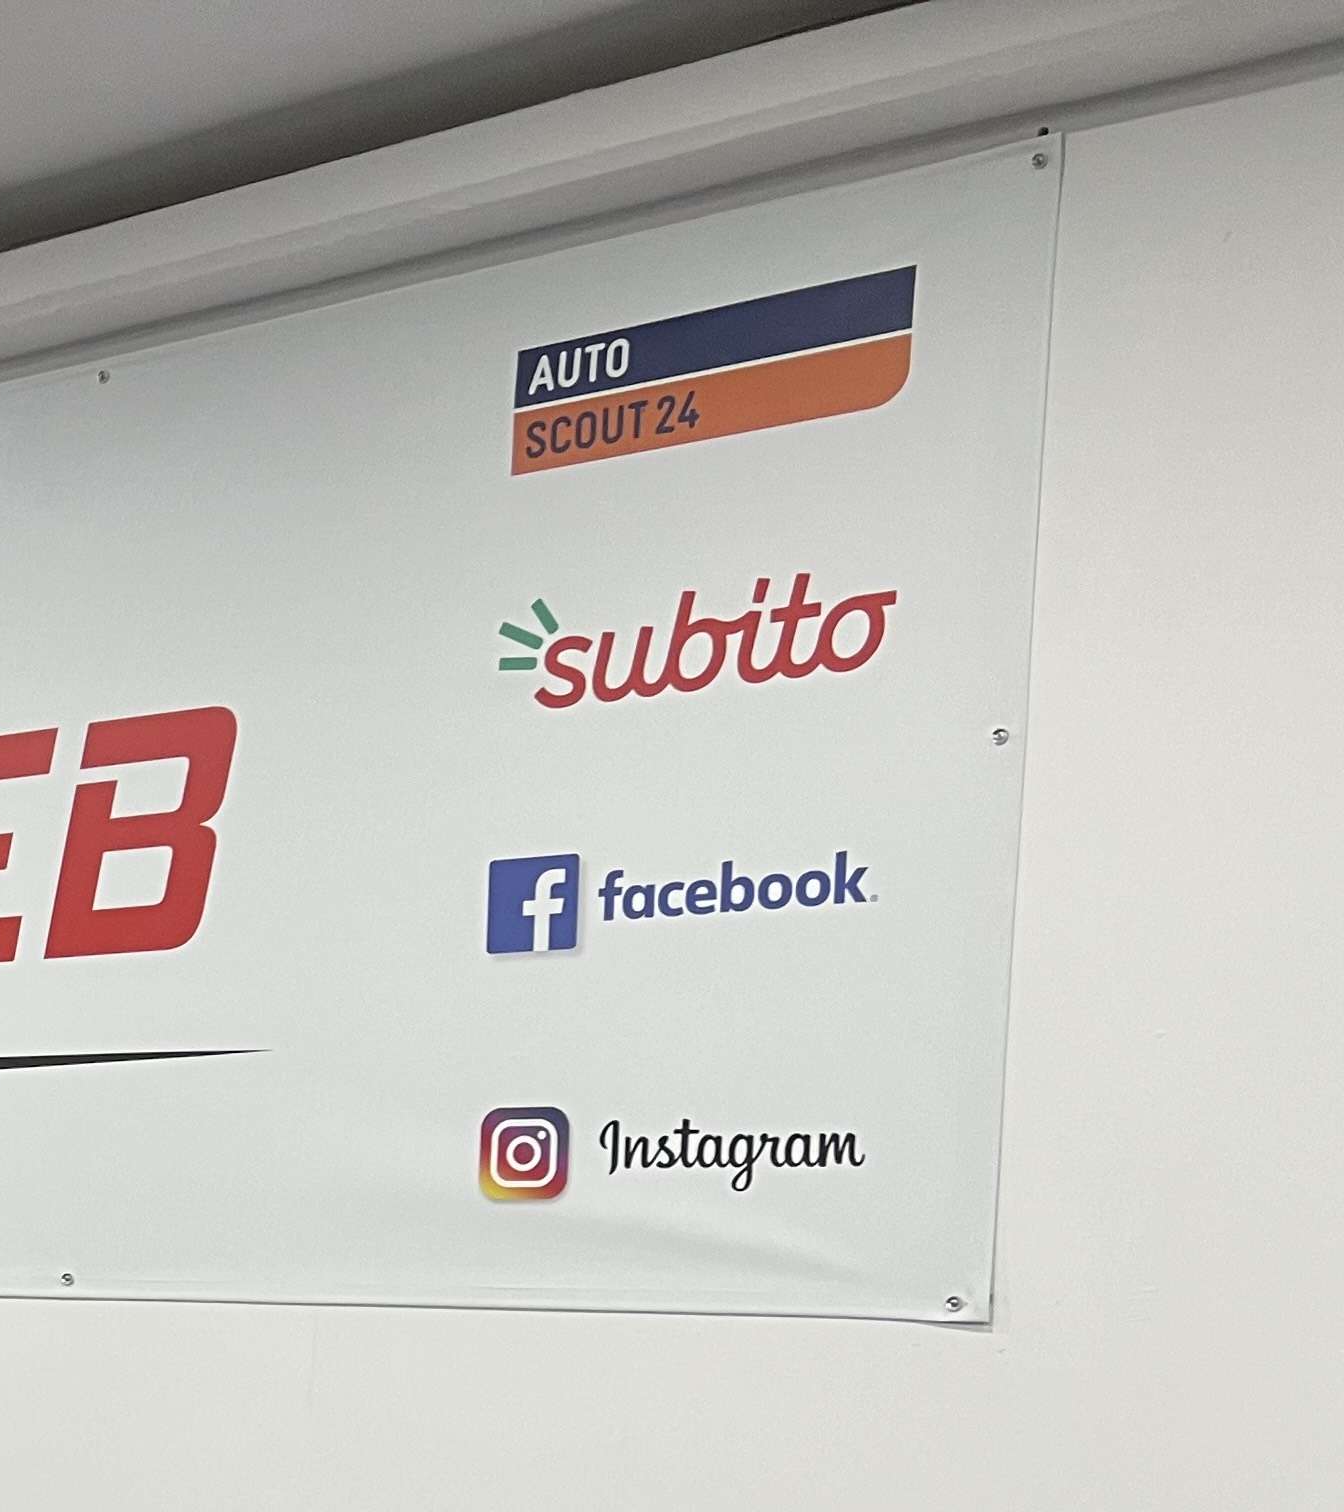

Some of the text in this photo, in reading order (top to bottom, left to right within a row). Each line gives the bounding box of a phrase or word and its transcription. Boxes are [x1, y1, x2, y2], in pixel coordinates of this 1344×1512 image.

[527, 337, 631, 396] AUTO
[525, 391, 700, 460] SCOUT 24
[534, 572, 898, 710] subito
[598, 850, 869, 922] facebook
[598, 1118, 866, 1192] Instagram
